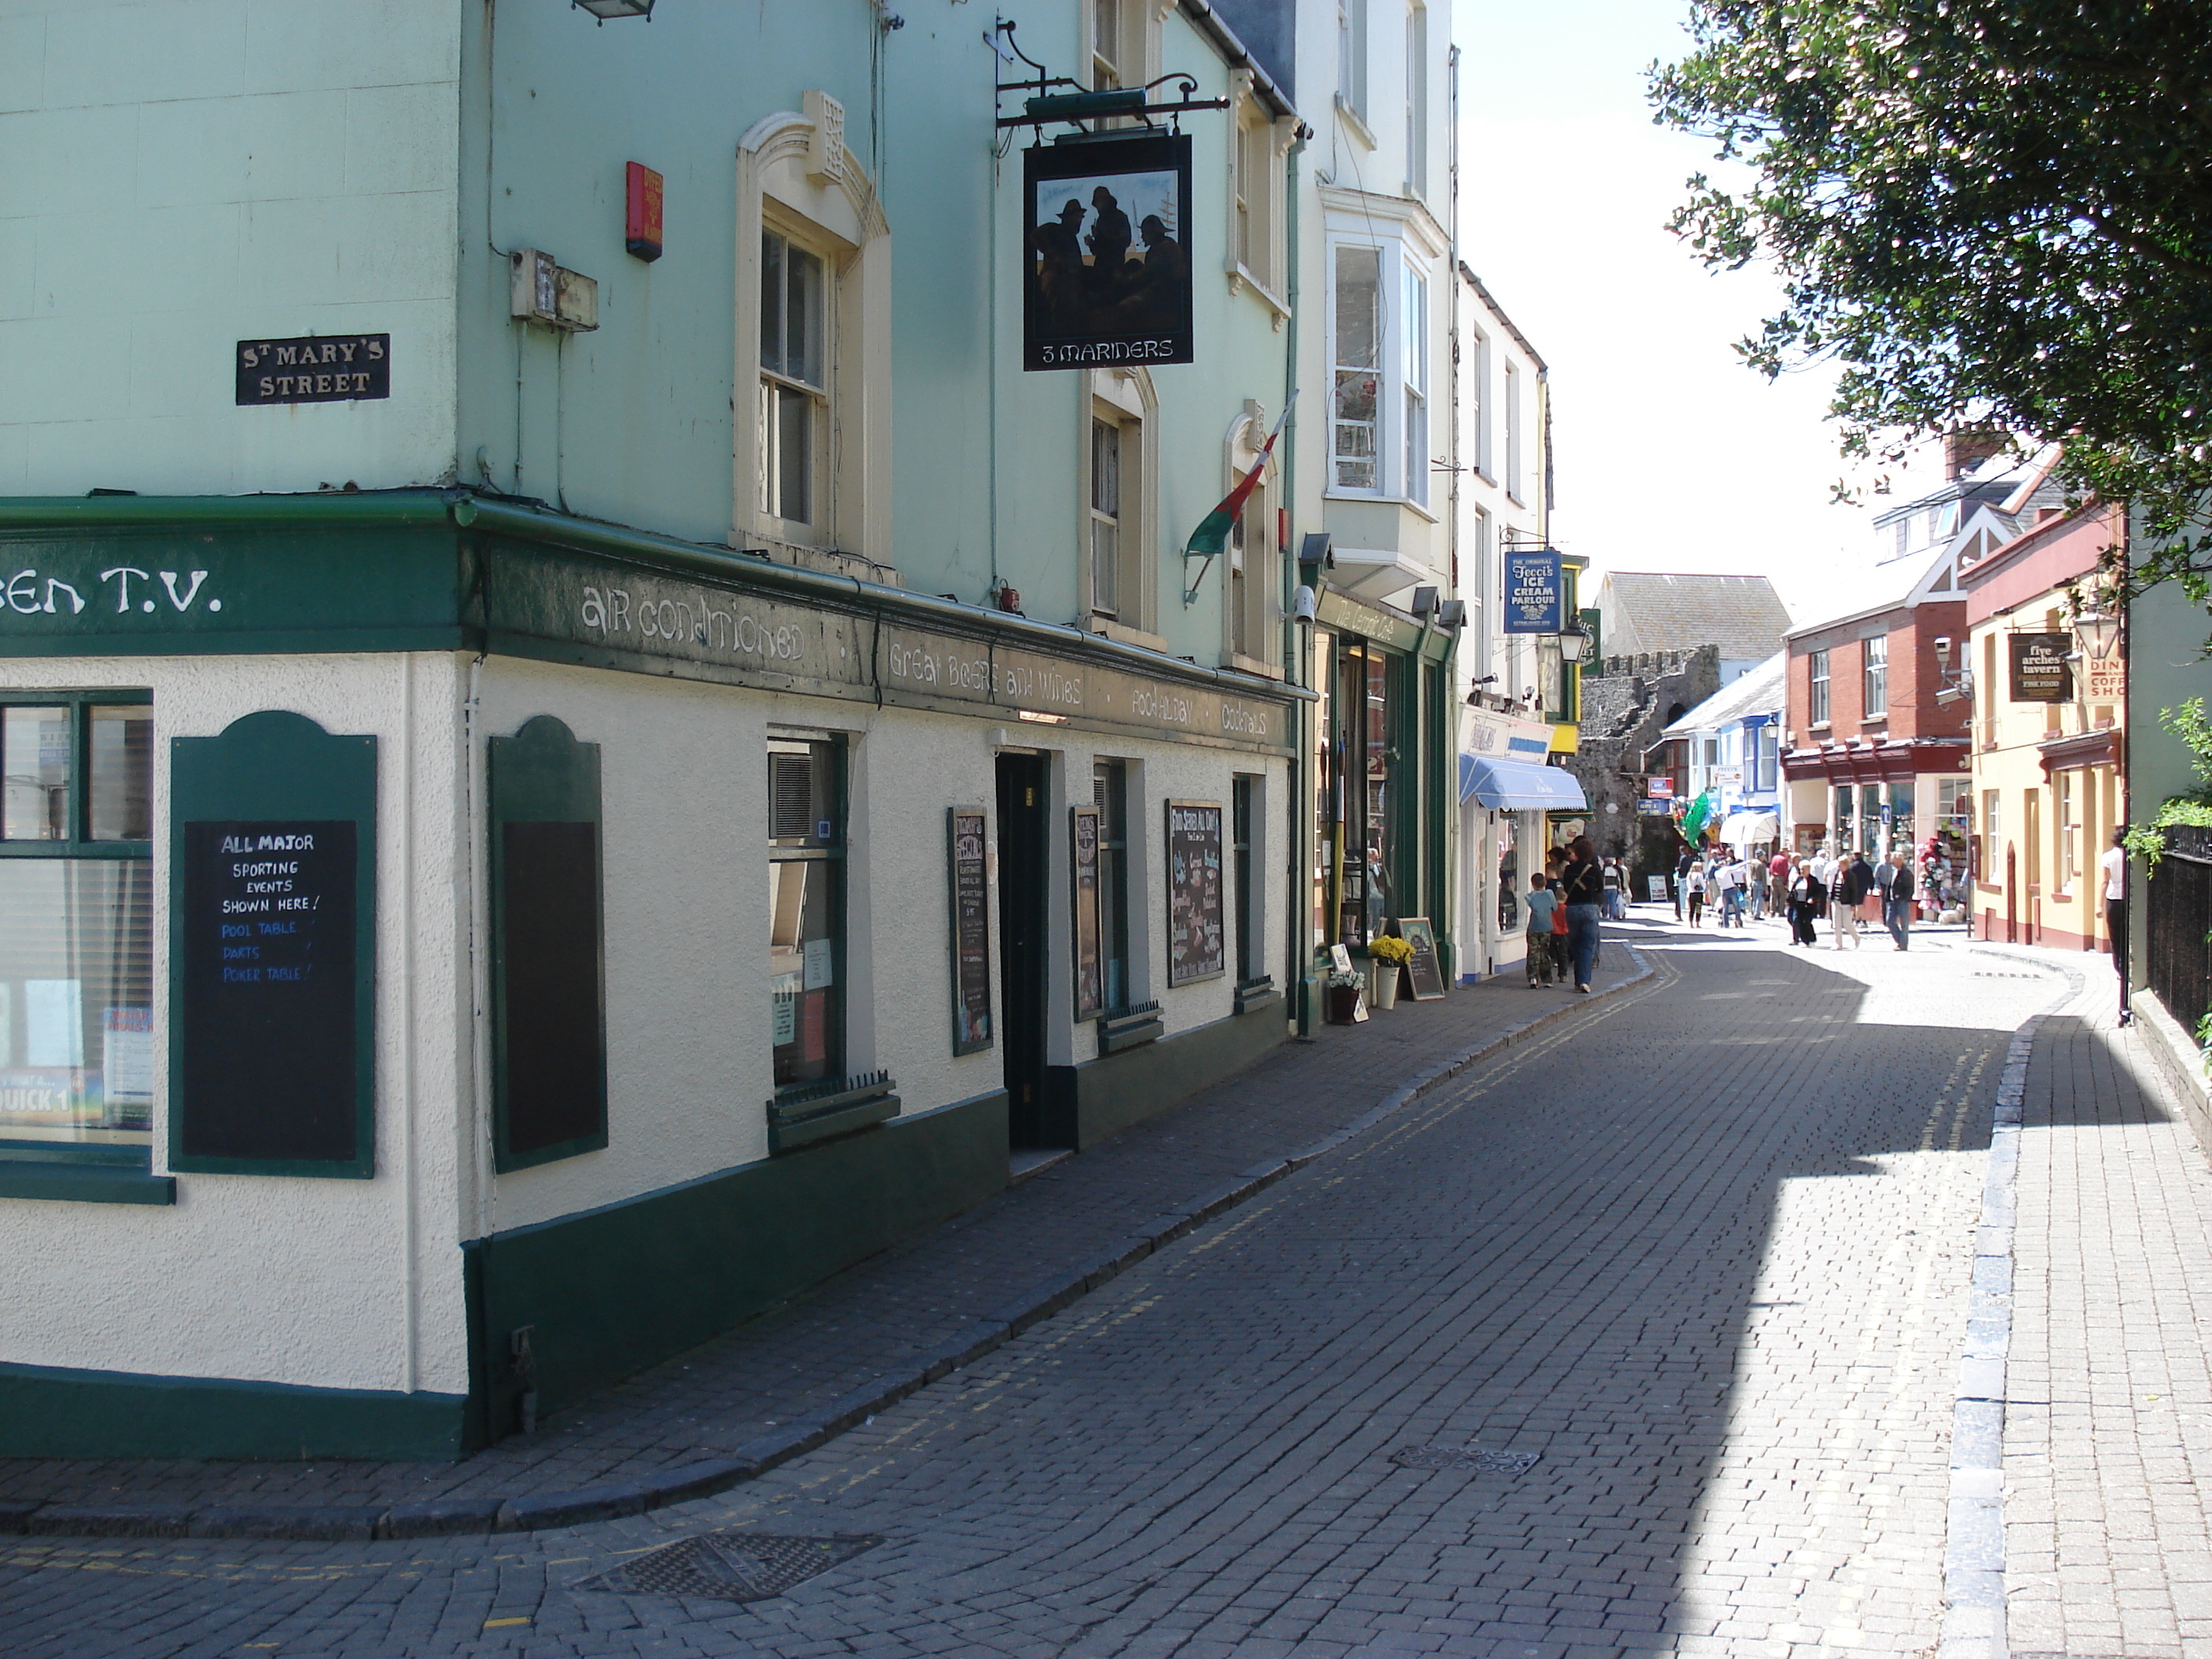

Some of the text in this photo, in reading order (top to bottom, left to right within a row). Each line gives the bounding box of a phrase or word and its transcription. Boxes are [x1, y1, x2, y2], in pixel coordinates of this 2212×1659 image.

[276, 338, 384, 365] MARY'S
[1042, 339, 1174, 363] 3 MARINERS
[259, 372, 371, 397] STREET
[101, 566, 222, 613] T.V.
[1522, 577, 1544, 588] ICE
[1513, 588, 1554, 596] CREAM
[1511, 596, 1555, 605] PARLOUR
[2030, 645, 2052, 655] five
[2022, 655, 2062, 665] arches
[2023, 665, 2061, 674] tavern
[221, 834, 314, 853] ALL MAJOR
[233, 861, 298, 878] SPORTING
[247, 880, 292, 894] EVENTS
[222, 899, 269, 914] SHOWN
[222, 921, 297, 939] POOL TABLE
[223, 947, 260, 960] DARTS
[223, 966, 261, 983] POKER
